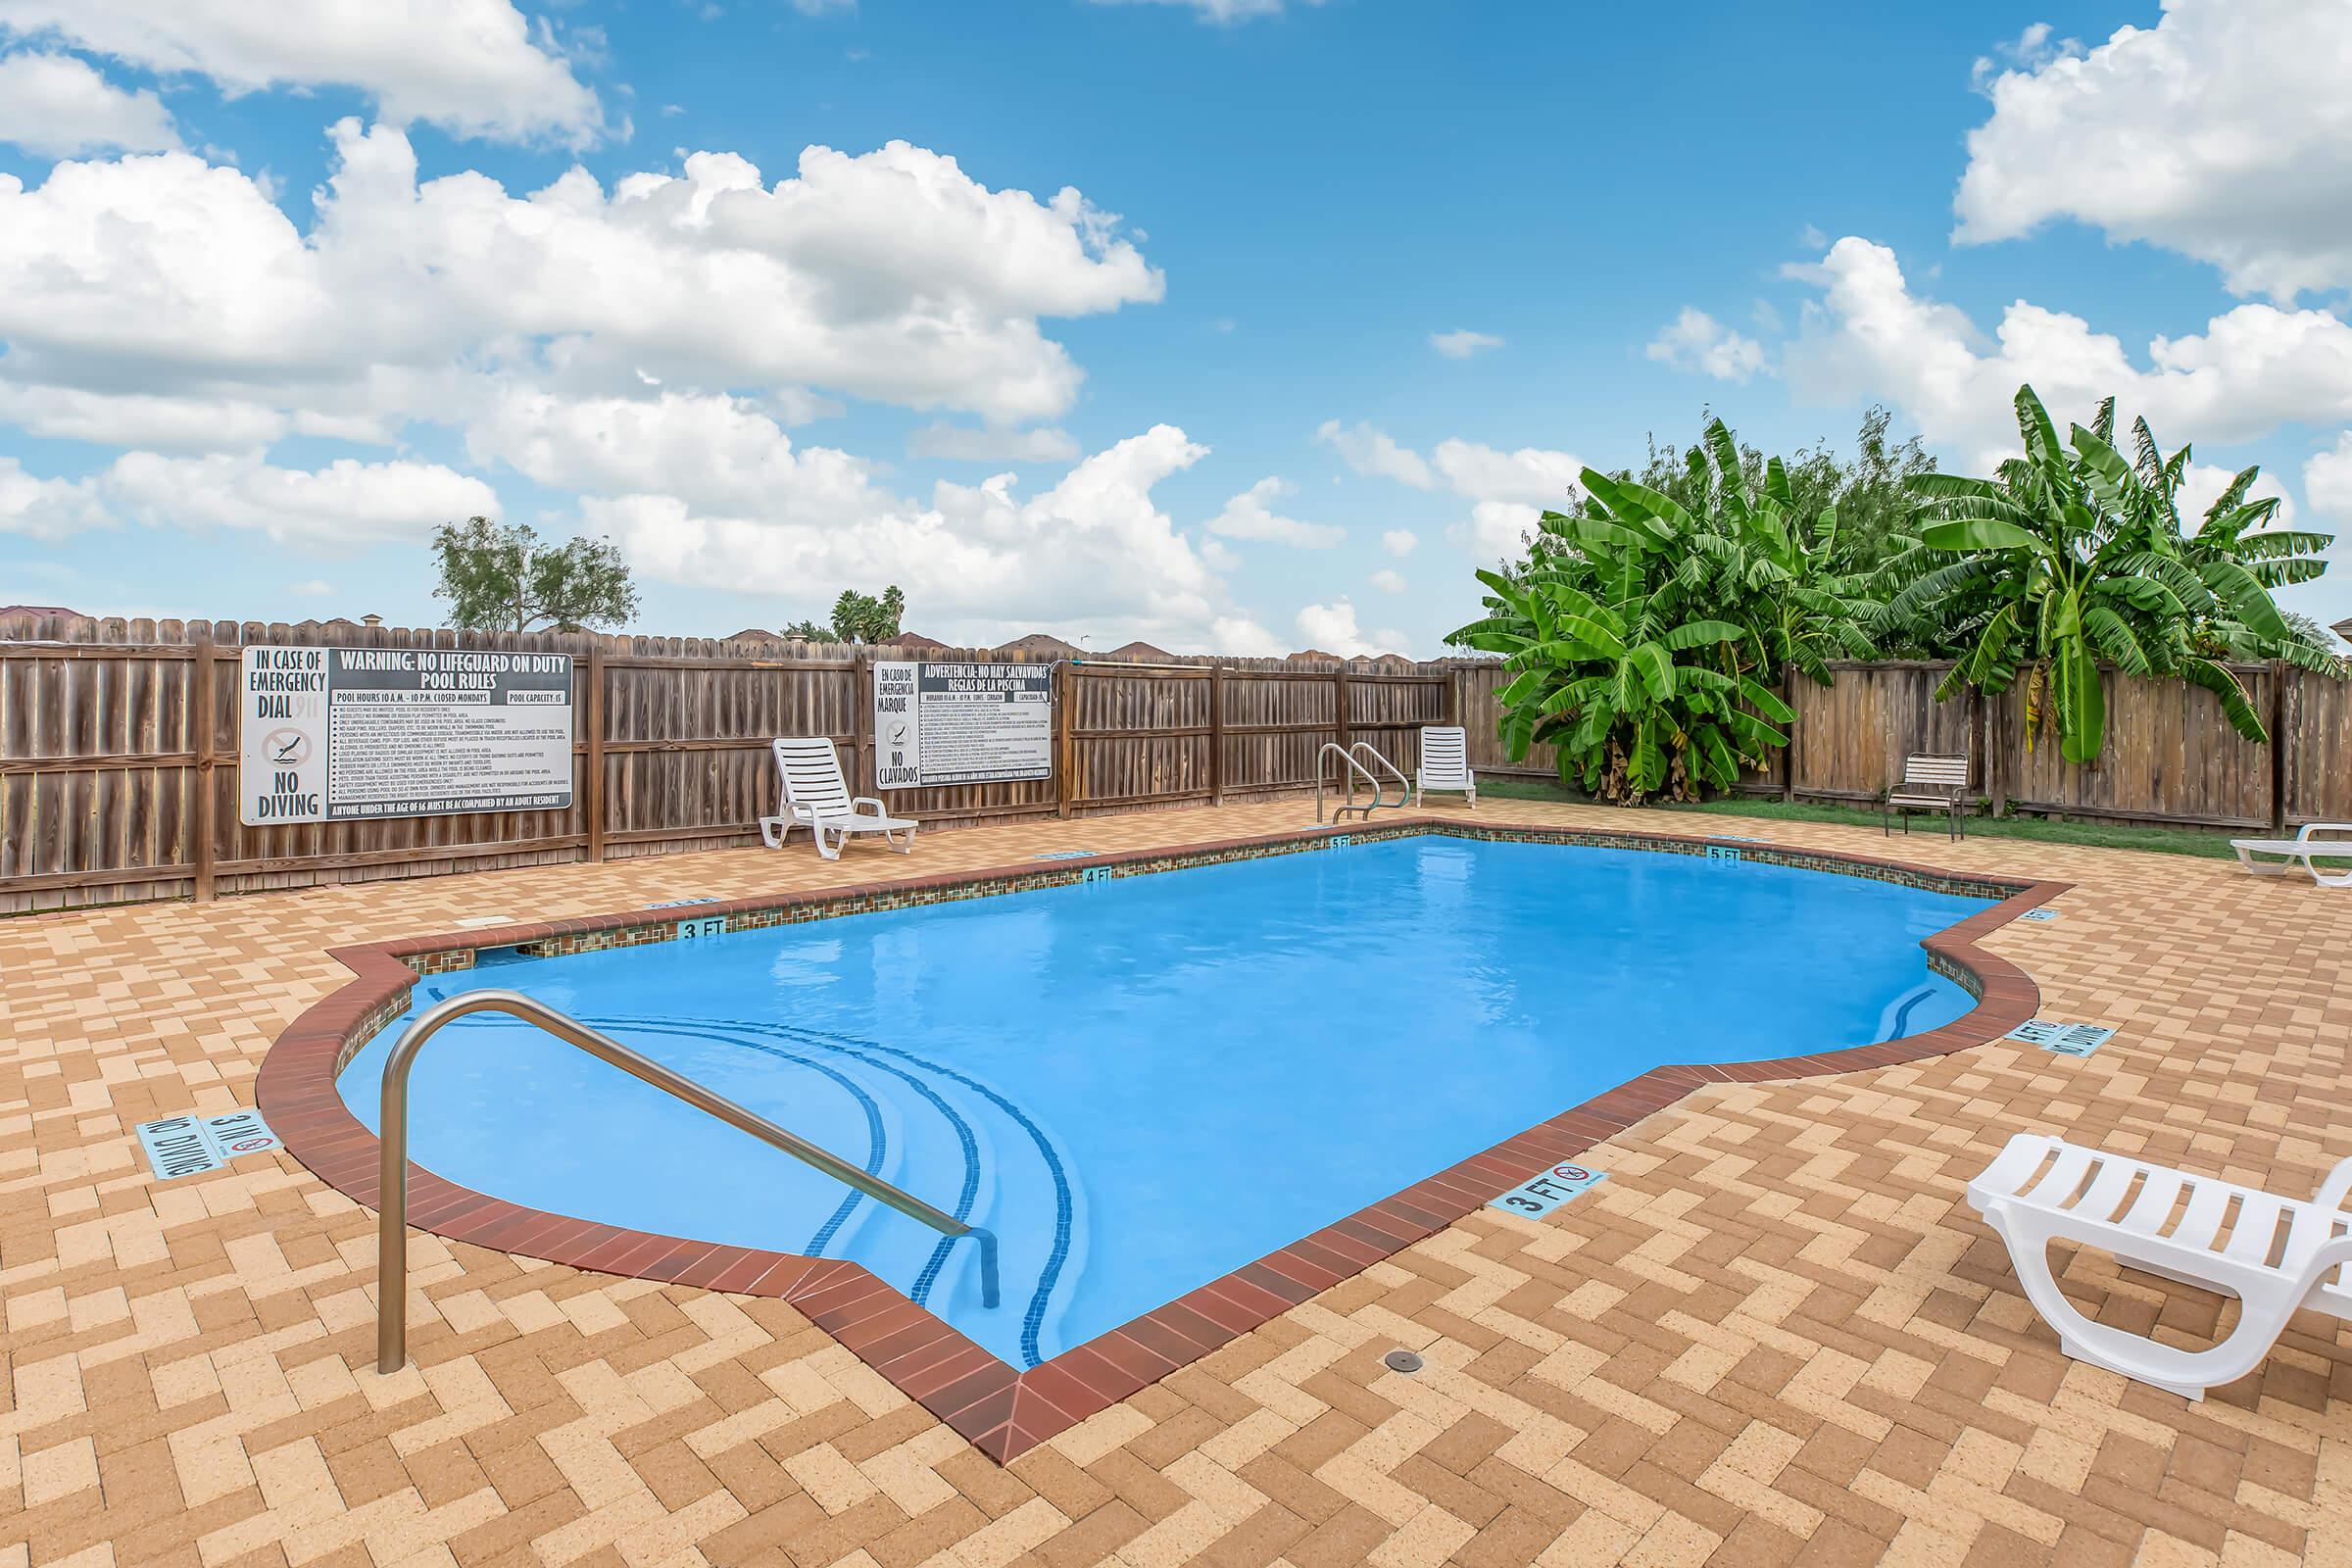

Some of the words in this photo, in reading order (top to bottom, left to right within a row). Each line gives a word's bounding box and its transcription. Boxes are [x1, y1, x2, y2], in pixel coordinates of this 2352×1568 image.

[256, 650, 270, 669] IN
[274, 650, 303, 669] CASE
[306, 651, 321, 670] OF
[339, 651, 416, 670] WARNING:
[417, 653, 437, 671] NO
[439, 653, 510, 672] LIFEGUARD
[512, 655, 529, 673] ON
[532, 656, 566, 673] DUTY
[250, 671, 326, 691] EMERGENCY
[420, 672, 456, 689] POOL
[459, 673, 497, 690] RULES
[882, 668, 889, 681] EN
[890, 668, 905, 681] CASO
[905, 668, 911, 681] DE
[978, 665, 989, 678] NO
[990, 665, 1004, 678] HAY
[1005, 665, 1047, 679] SALVAVIDAS
[879, 683, 914, 695] EMERGENCIA
[948, 679, 975, 692] REGLAS
[976, 679, 987, 692] DE
[987, 679, 996, 692] LA
[997, 679, 1026, 692] PISCINA
[258, 695, 292, 718] DIAL
[296, 695, 318, 717] 911
[337, 693, 355, 703] POOL
[357, 693, 379, 703] HOURS
[381, 693, 389, 703] 10
[412, 693, 418, 703] 10
[434, 693, 456, 703] CLOSED
[458, 693, 487, 703] MONDAYS
[510, 694, 524, 703] POOL
[878, 697, 906, 713] MARQUE
[892, 751, 903, 767] NO
[274, 771, 299, 794] NO
[879, 766, 918, 784] CLAVADOS
[258, 793, 318, 817] DIVING
[332, 806, 359, 815] ANYONE
[361, 804, 383, 814] UNDER
[383, 804, 396, 813] THE
[396, 803, 409, 812] AGE
[410, 802, 418, 811] OF
[418, 802, 426, 810] 16
[427, 800, 445, 810] MUST
[446, 800, 455, 809] BE
[455, 798, 496, 809] ACCOMPANIED
[496, 798, 505, 807] BY
[505, 797, 514, 807] AN
[514, 796, 533, 807] ADULT
[533, 795, 560, 805] RESIDENT
[1341, 837, 1349, 847] FT
[1711, 848, 1719, 858] 5
[1724, 850, 1739, 860] FT
[1087, 870, 1094, 882] 4
[1098, 868, 1110, 881] FT
[684, 924, 696, 939] 3
[704, 919, 723, 936] FT
[145, 1116, 191, 1134] NO
[210, 1114, 252, 1126] 3
[153, 1134, 213, 1176] DIVING
[1505, 1197, 1544, 1212] 3
[1525, 1178, 1574, 1200] FT
